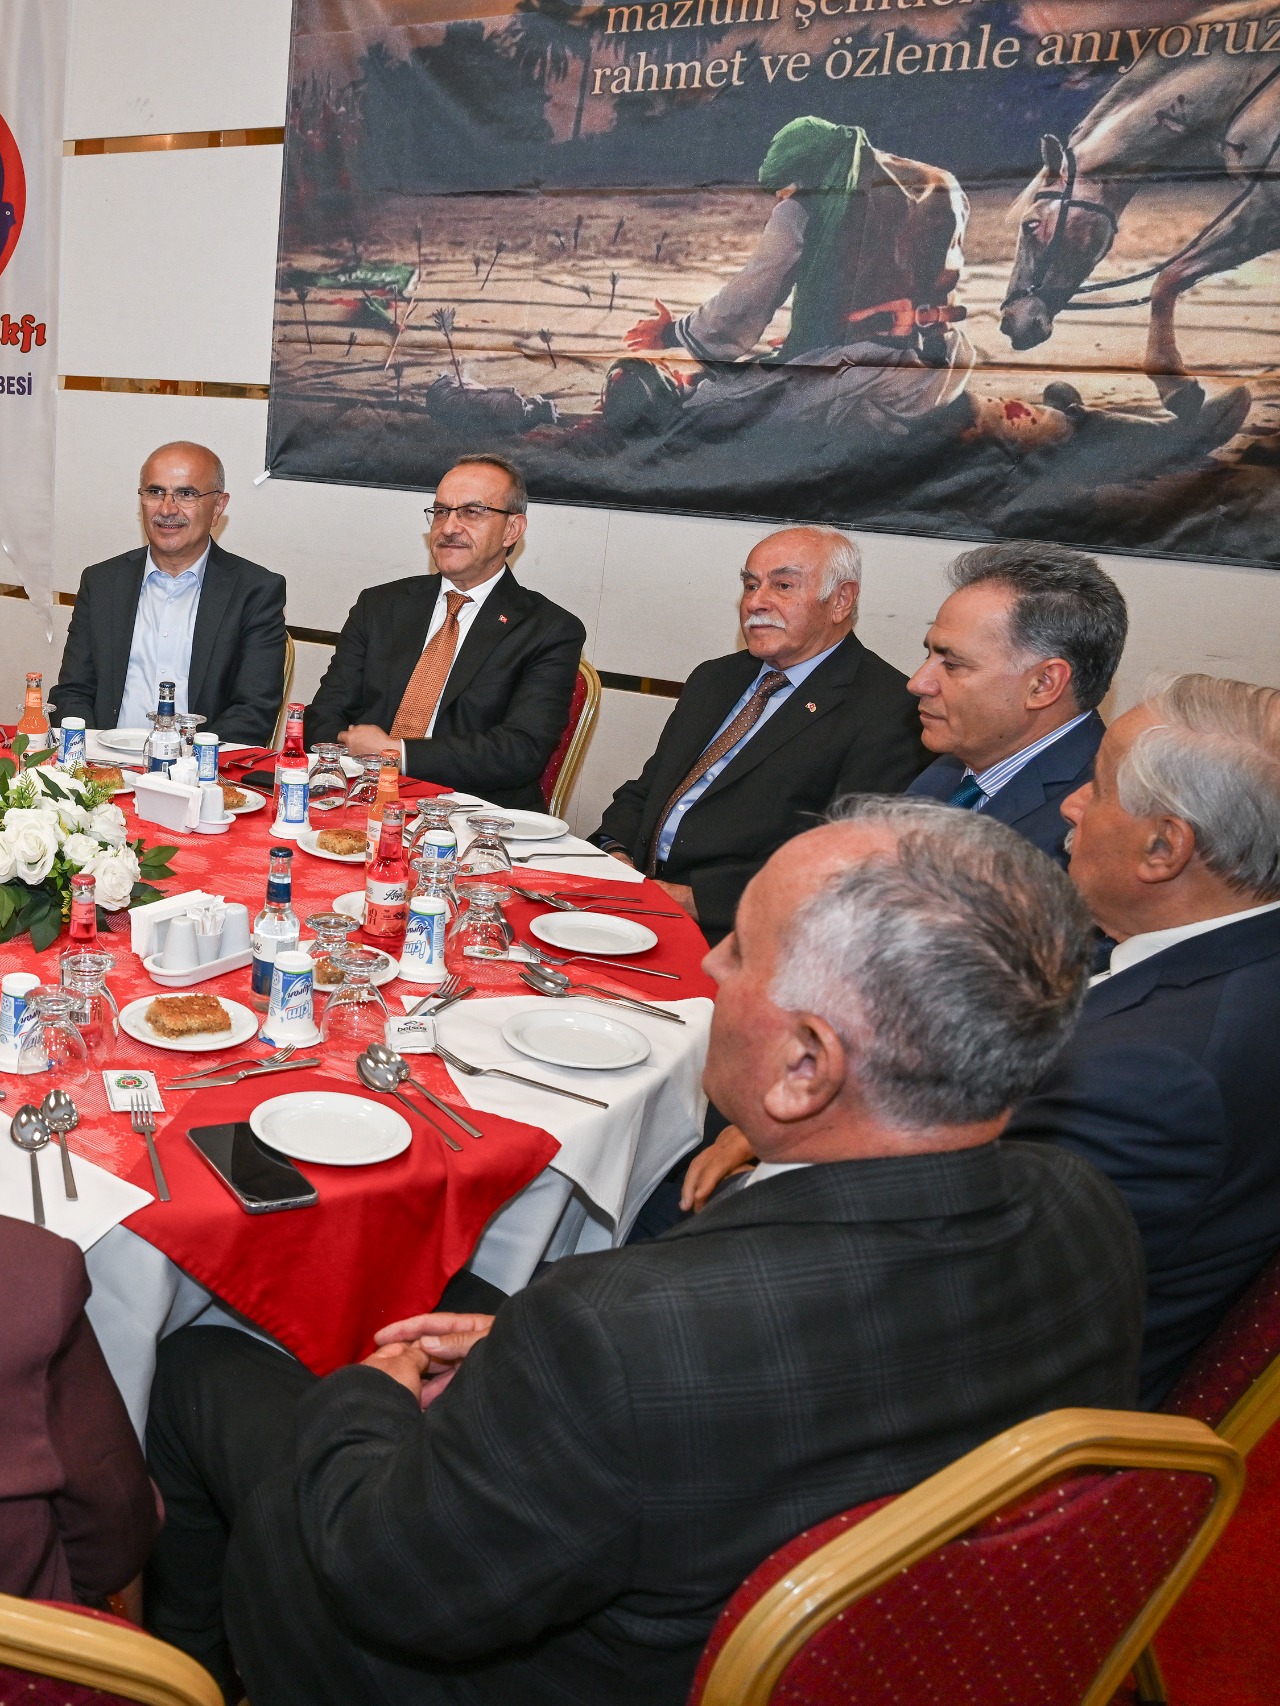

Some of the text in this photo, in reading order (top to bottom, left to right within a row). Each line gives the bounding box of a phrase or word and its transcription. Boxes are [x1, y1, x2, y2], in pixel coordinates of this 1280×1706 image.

[591, 19, 1280, 95] rahmet ve özlemle anıyoruz
